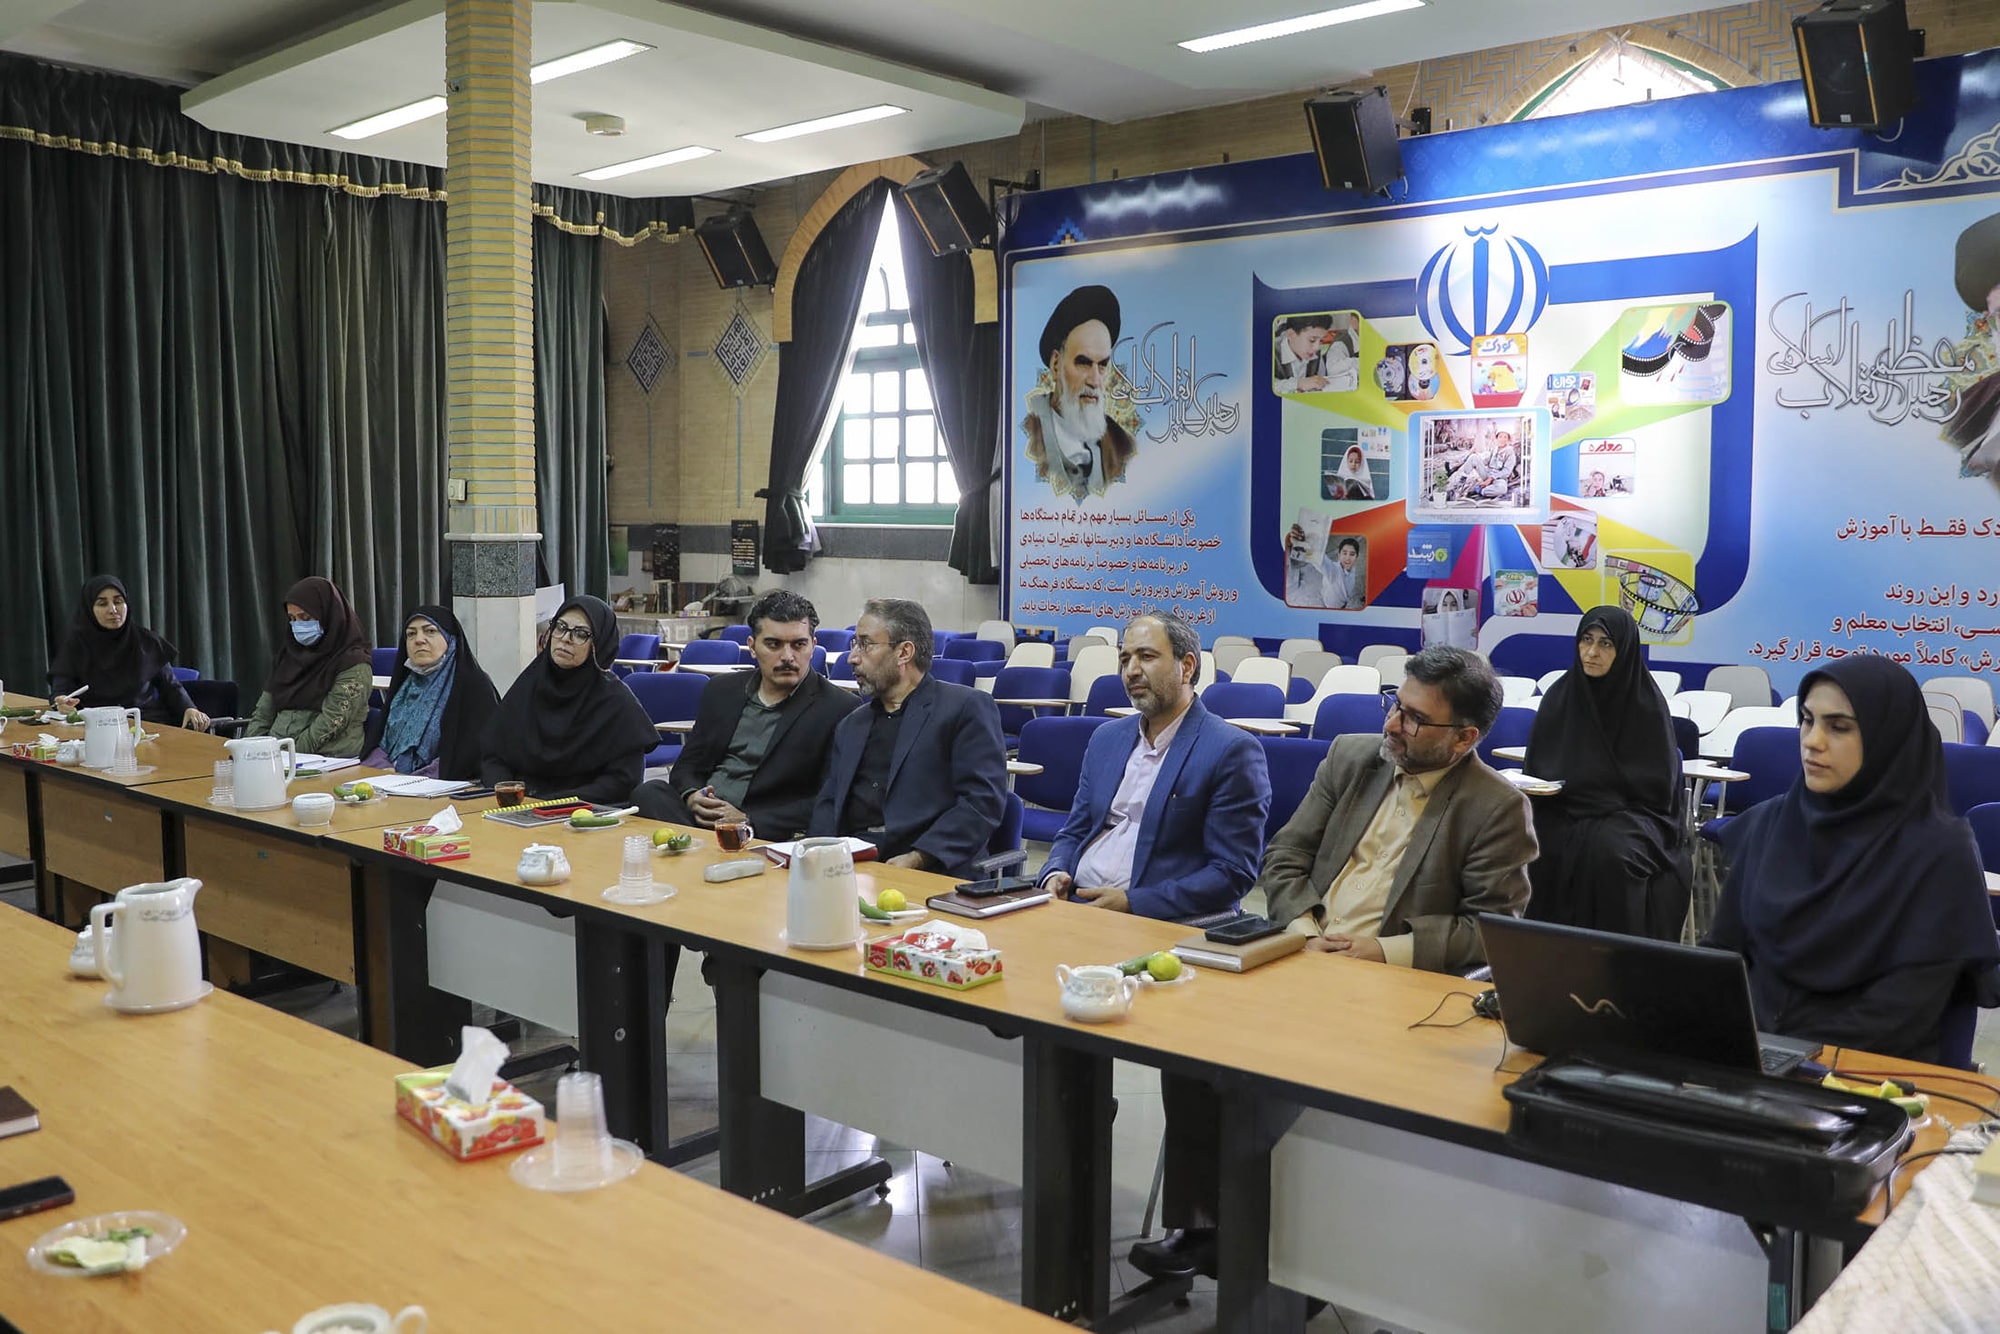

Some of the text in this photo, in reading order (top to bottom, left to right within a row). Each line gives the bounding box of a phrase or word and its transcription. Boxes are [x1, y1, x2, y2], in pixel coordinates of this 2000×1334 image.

[1077, 511, 1088, 525] در
[1090, 511, 1107, 528] مهم
[1108, 508, 1132, 526] بسیار
[1837, 514, 1898, 540] آموزش
[1916, 517, 1968, 537] فقط
[1900, 518, 1912, 541] با
[1884, 583, 1925, 604] روند
[1928, 583, 1956, 607] این
[1958, 590, 1970, 606] و
[1830, 616, 1843, 633] و
[1846, 611, 1888, 639] معلم
[1890, 613, 1951, 638] انتخاب
[1789, 641, 1822, 662] قرار
